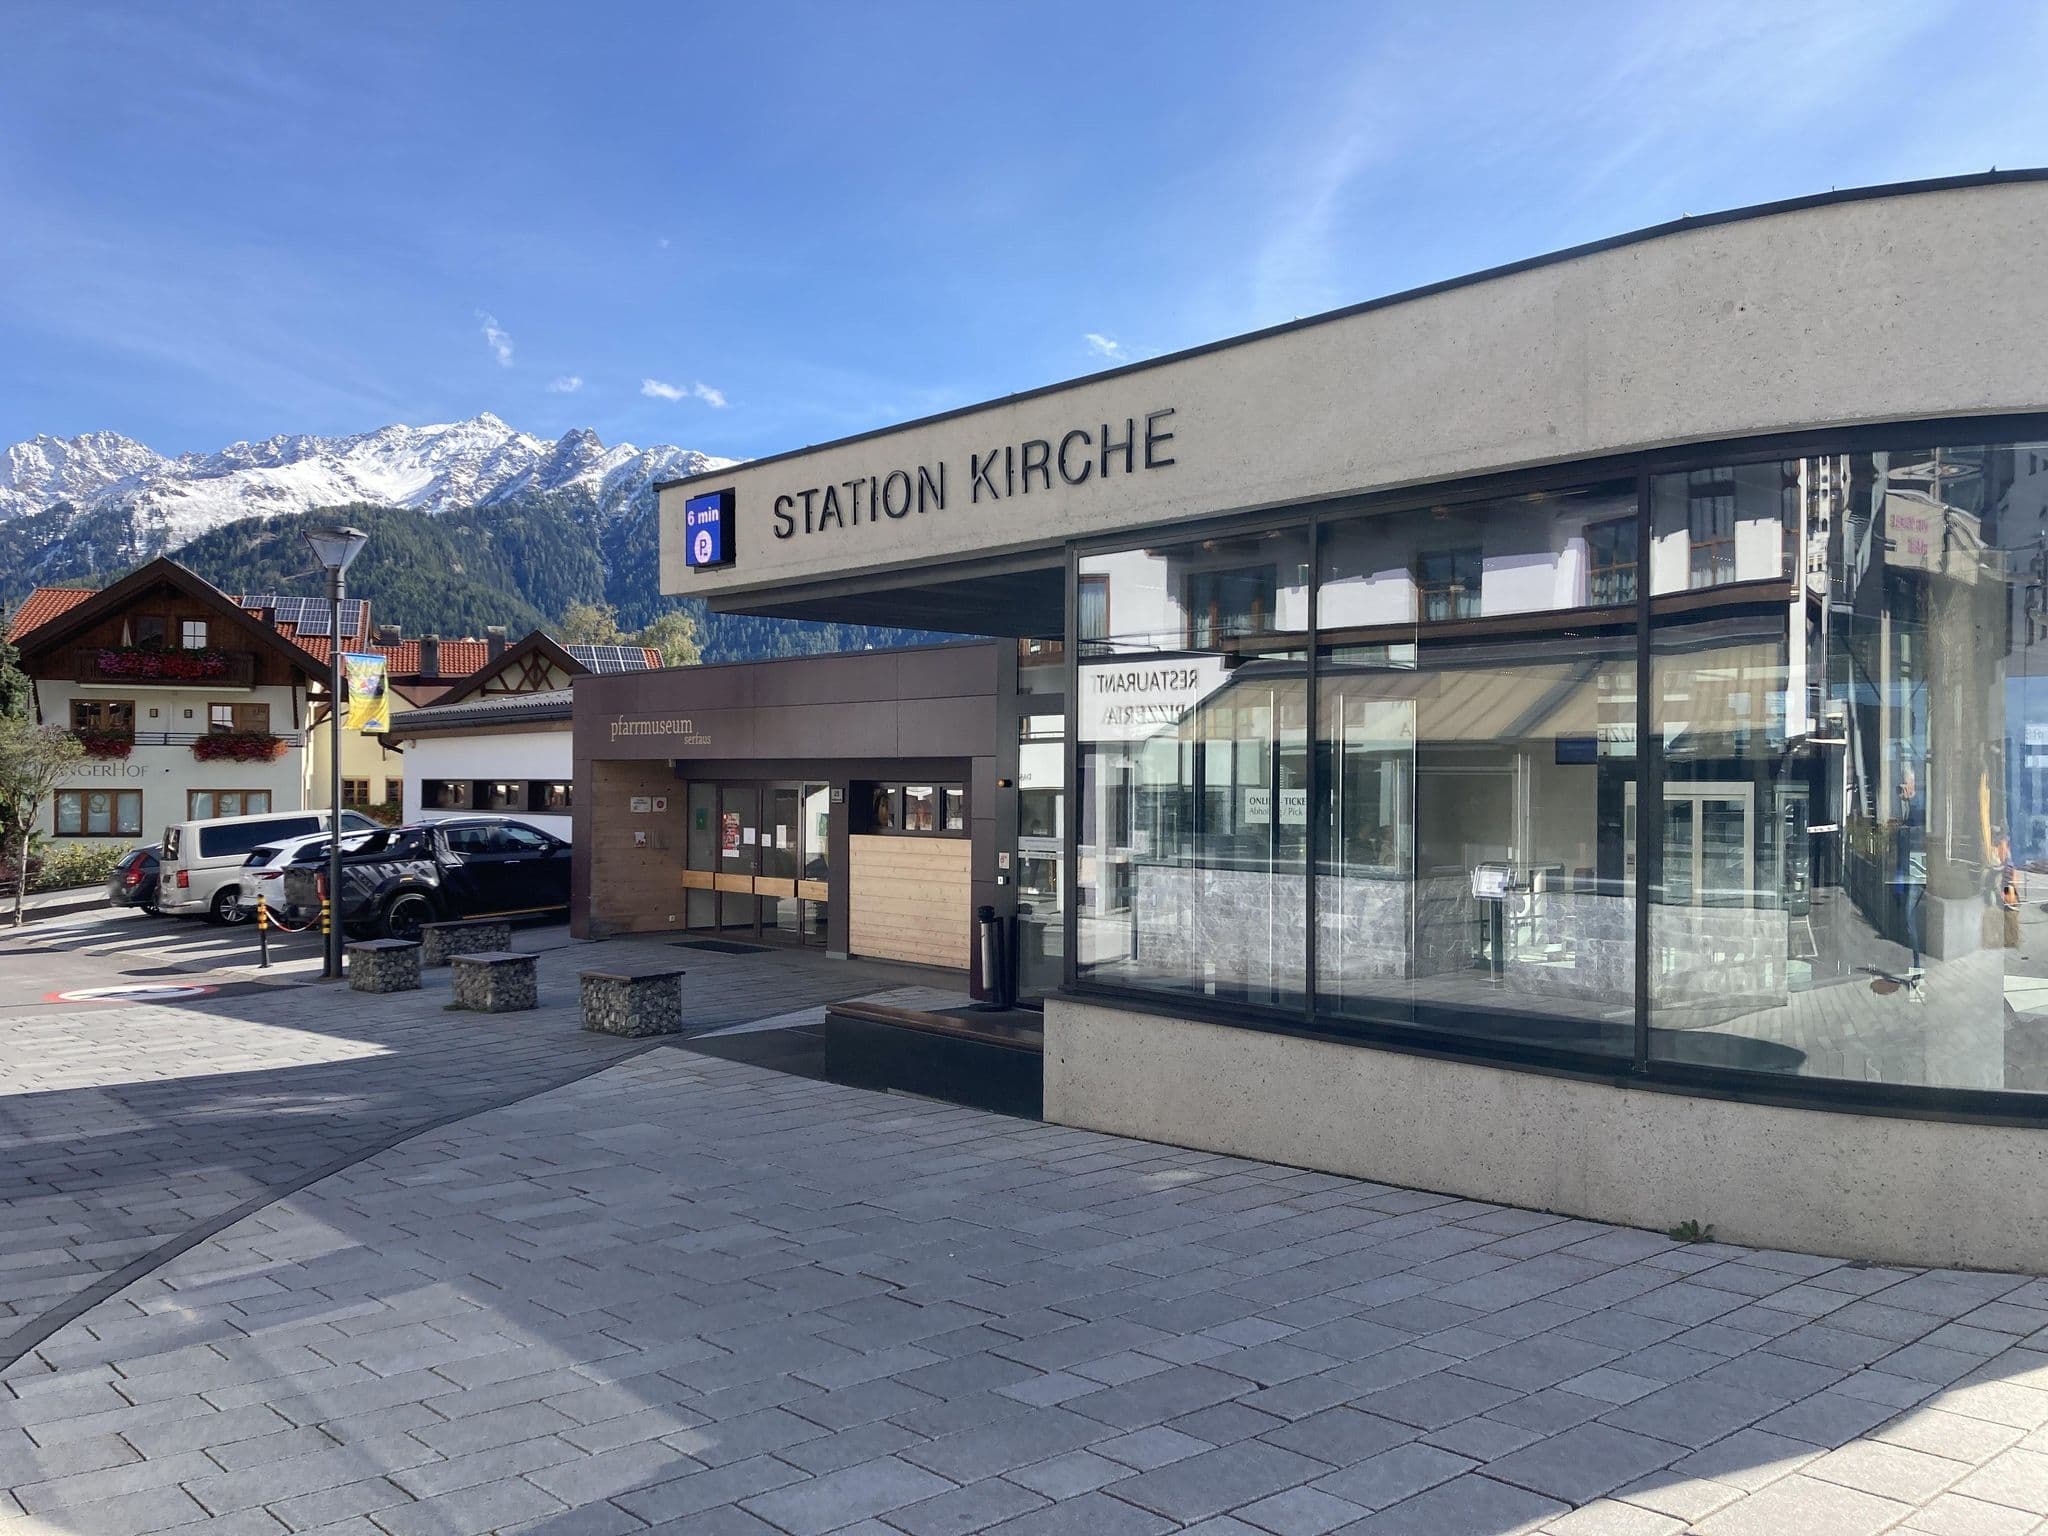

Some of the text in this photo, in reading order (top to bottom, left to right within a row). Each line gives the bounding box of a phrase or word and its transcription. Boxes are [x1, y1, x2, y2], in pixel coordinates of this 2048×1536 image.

[773, 407, 1176, 540] STATION KIRCHE
[687, 506, 719, 526] 6 min
[610, 714, 693, 742] pfarrmuseum
[684, 731, 712, 745] serfaus
[1249, 797, 1269, 806] ONLI
[1285, 797, 1306, 806] TICKE
